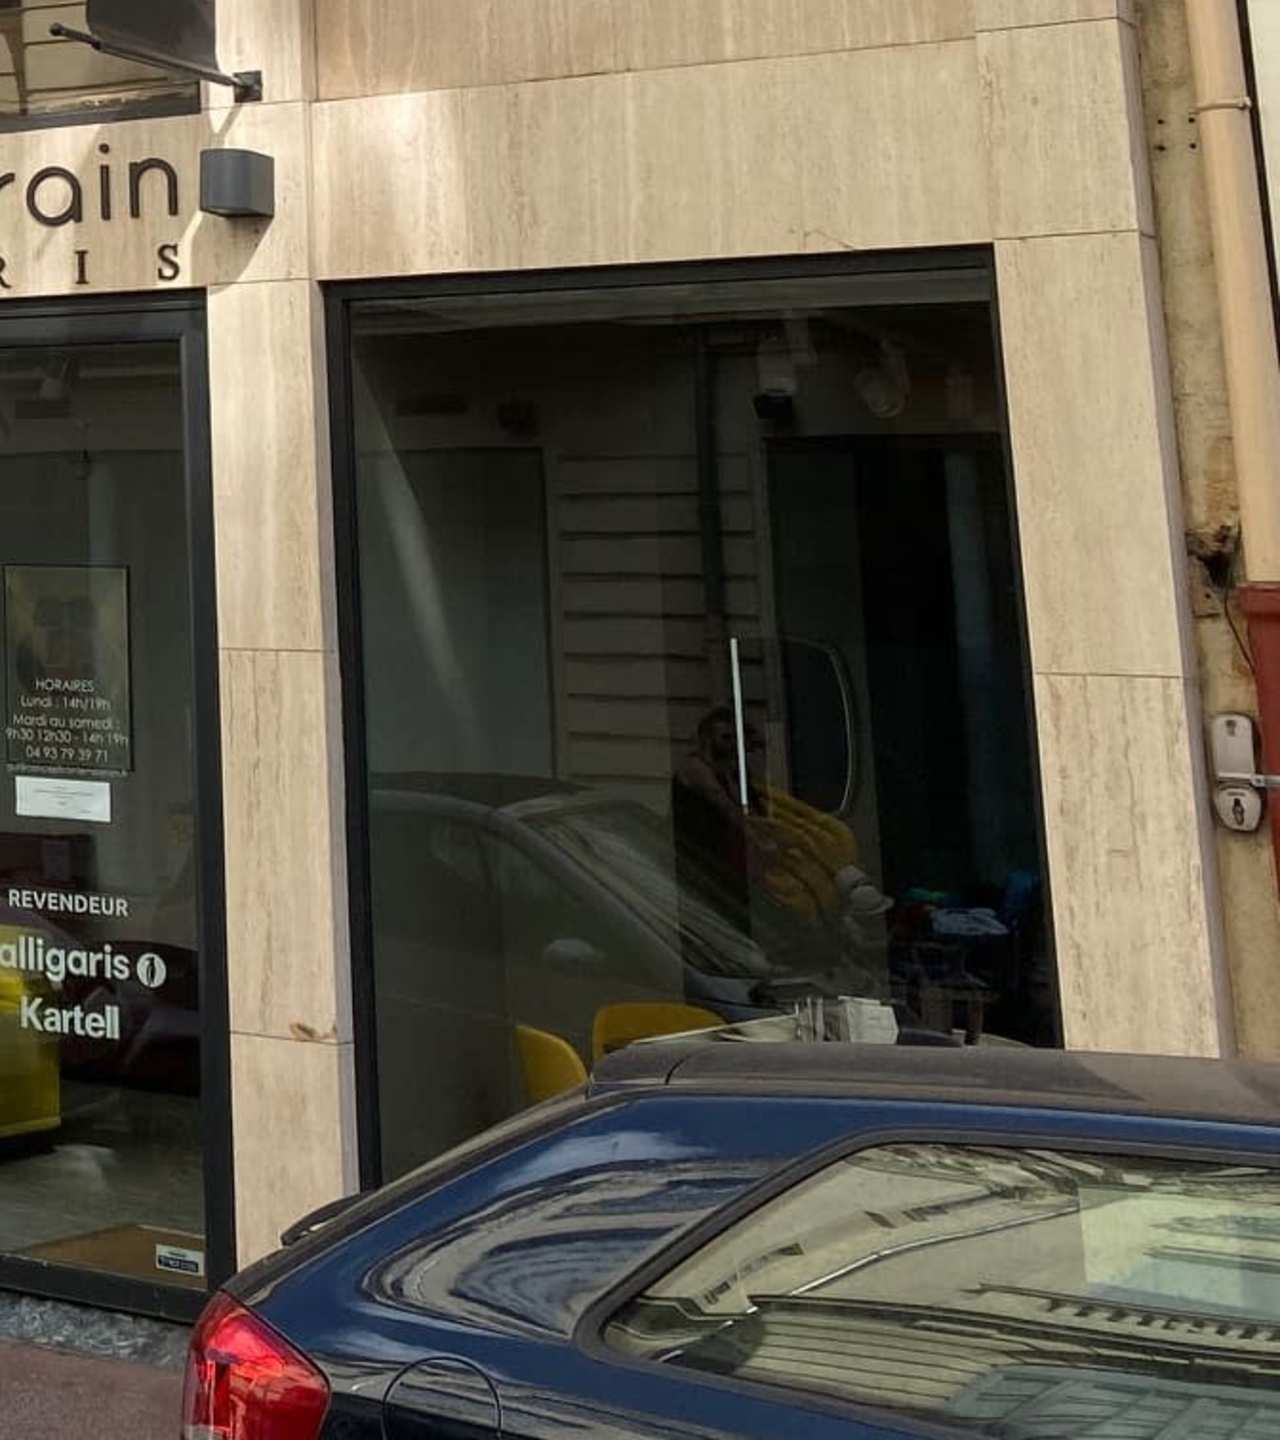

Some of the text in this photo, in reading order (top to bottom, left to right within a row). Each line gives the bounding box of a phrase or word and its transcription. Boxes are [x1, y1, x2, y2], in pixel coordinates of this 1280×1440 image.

[35, 679, 95, 692] HORAIRES
[20, 695, 52, 708] Lundi
[13, 714, 46, 727] Mardi
[49, 718, 66, 727] au
[69, 718, 113, 730] samedi
[26, 746, 40, 758] 04
[8, 889, 129, 917] REVENDEUR
[20, 996, 120, 1040] Kartell
